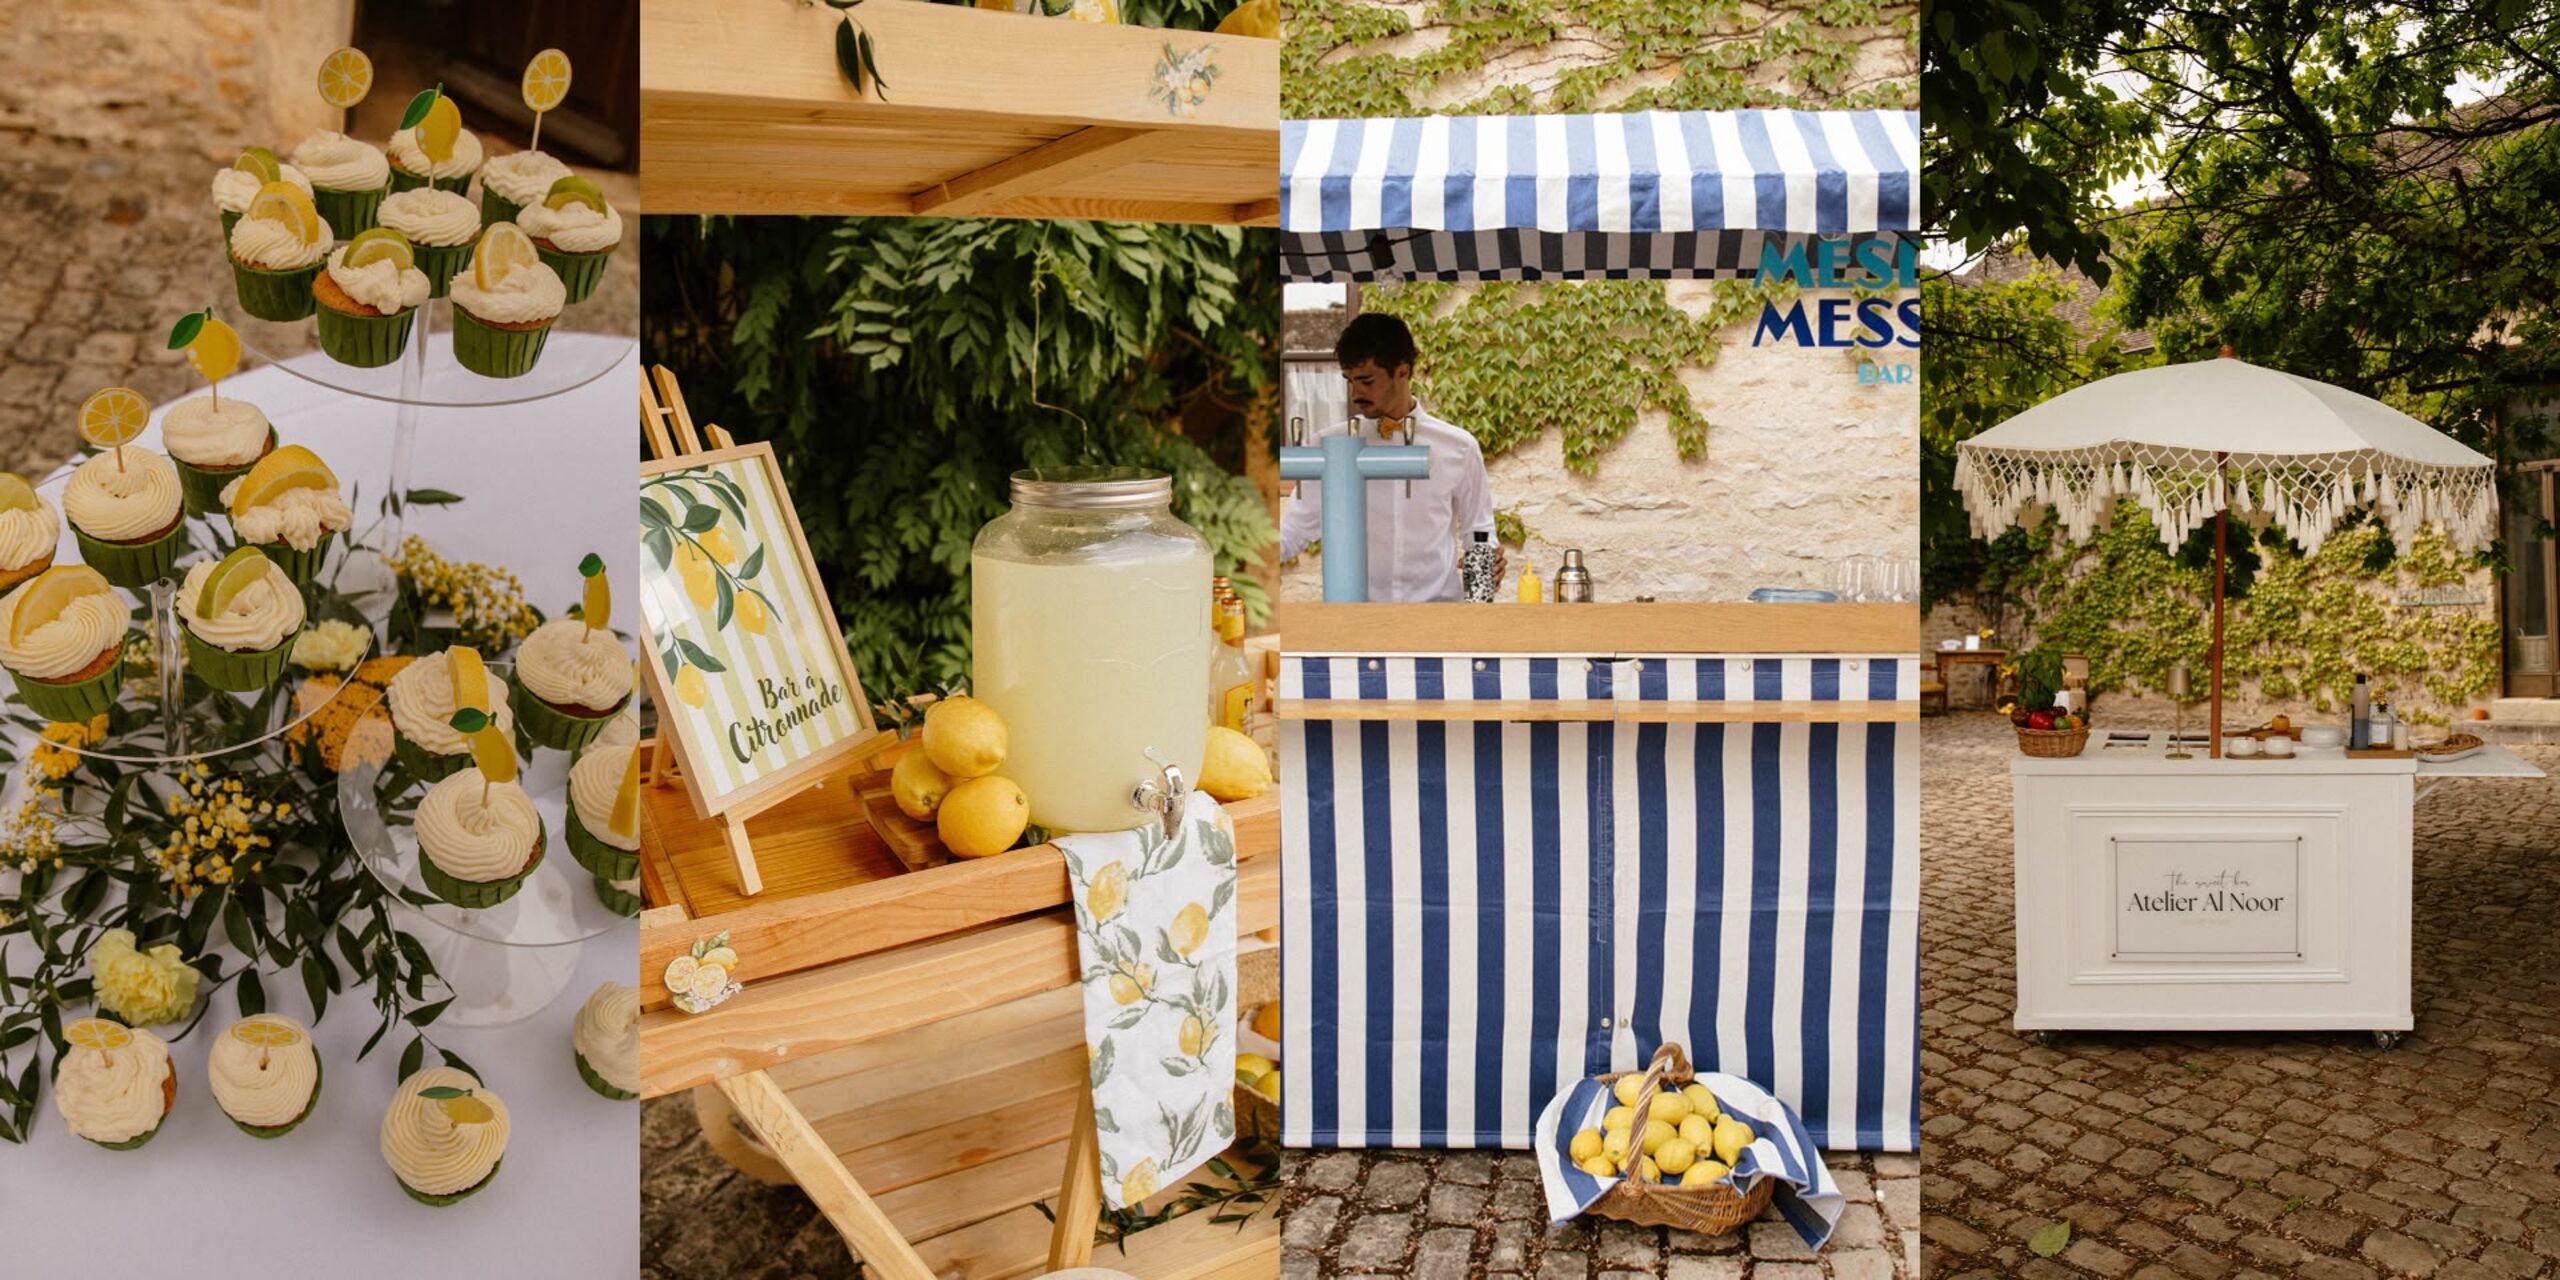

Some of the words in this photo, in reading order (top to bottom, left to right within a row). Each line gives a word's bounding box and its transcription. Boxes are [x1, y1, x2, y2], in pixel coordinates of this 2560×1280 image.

[1858, 362, 1913, 385] BAR
[757, 677, 800, 710] Bar
[805, 668, 819, 691] à
[728, 678, 843, 765] Citronnade
[2127, 890, 2198, 912] Atelier
[2202, 890, 2224, 912] Al
[2229, 892, 2285, 912] Noor
